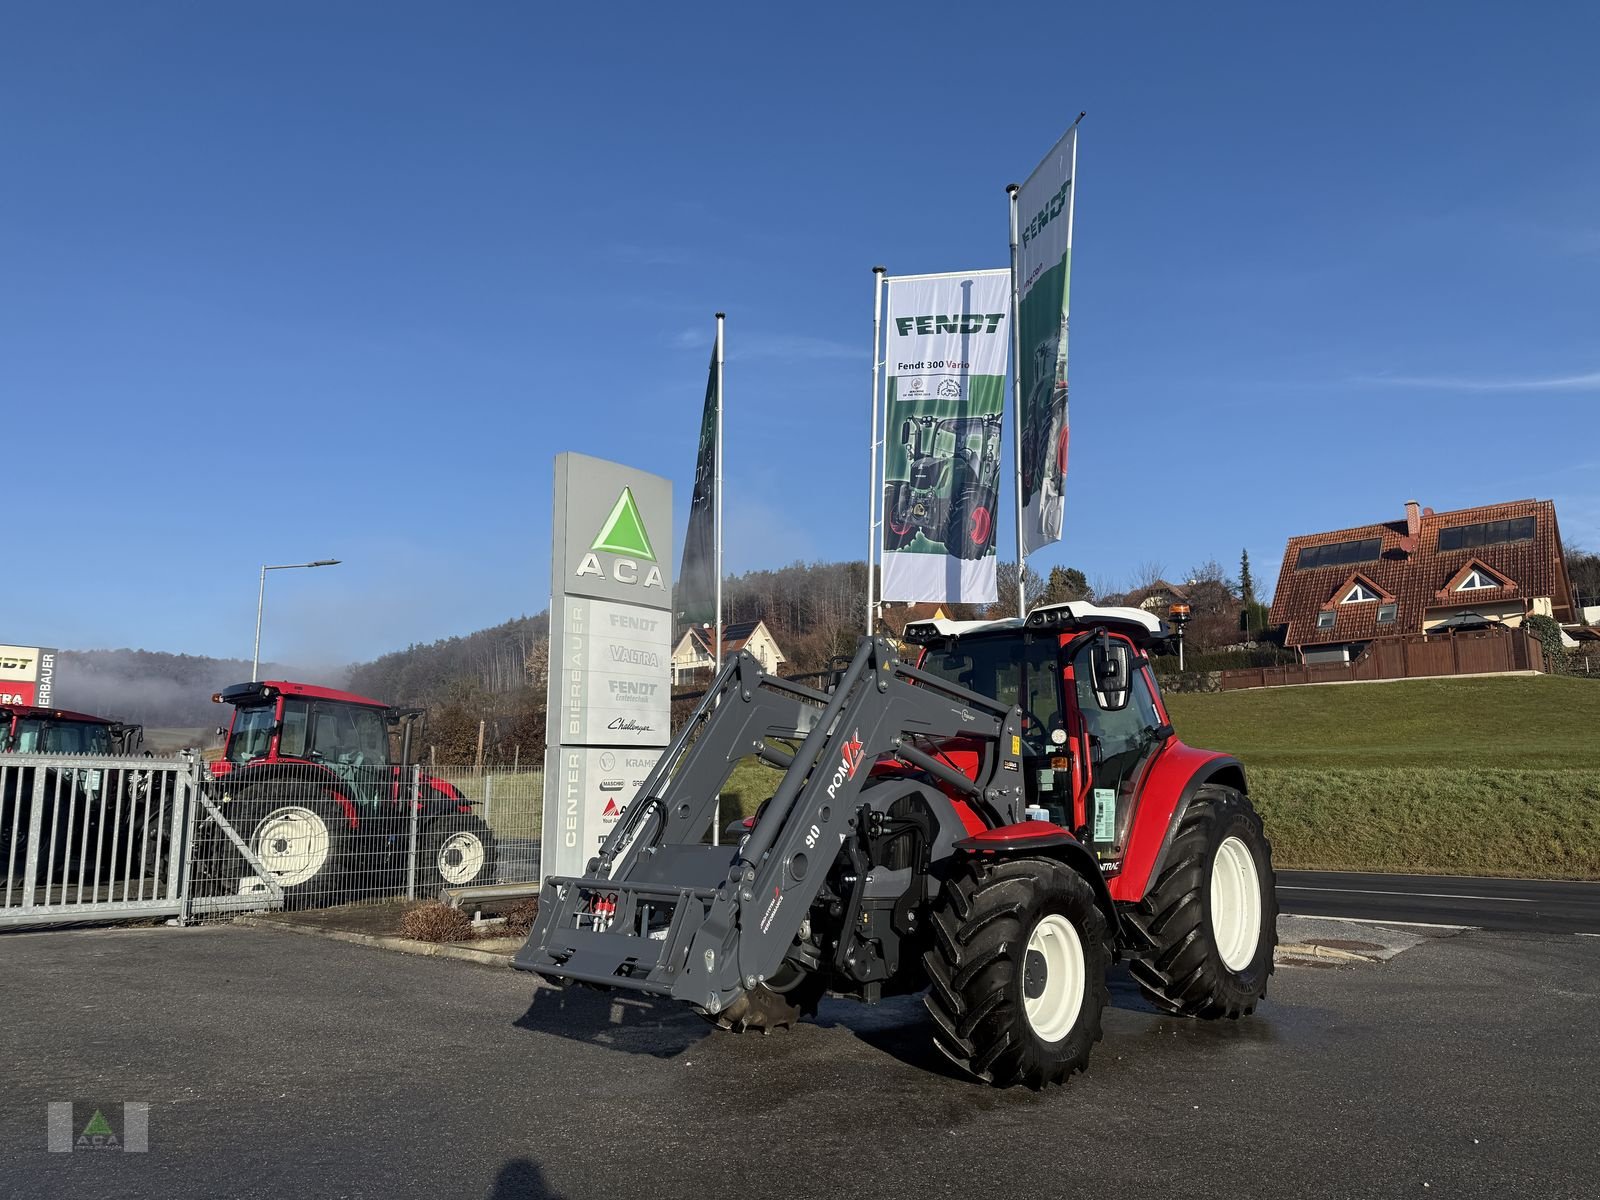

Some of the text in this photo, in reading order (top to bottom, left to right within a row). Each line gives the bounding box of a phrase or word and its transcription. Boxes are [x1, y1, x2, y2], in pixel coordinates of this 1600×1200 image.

[895, 313, 1005, 337] FENDT
[898, 361, 970, 370] Fendt 300 Vario
[574, 552, 667, 592] ACA
[609, 614, 659, 632] FENDT
[0, 657, 33, 669] DT
[609, 645, 659, 668] VALTRA
[39, 654, 54, 708] IERBAUER
[570, 607, 585, 735] BIERBAUER
[608, 680, 658, 696] FENDT
[607, 717, 656, 735] Challenger
[625, 758, 659, 768] KRAME
[565, 754, 580, 848] CENTER
[805, 824, 821, 849] 90
